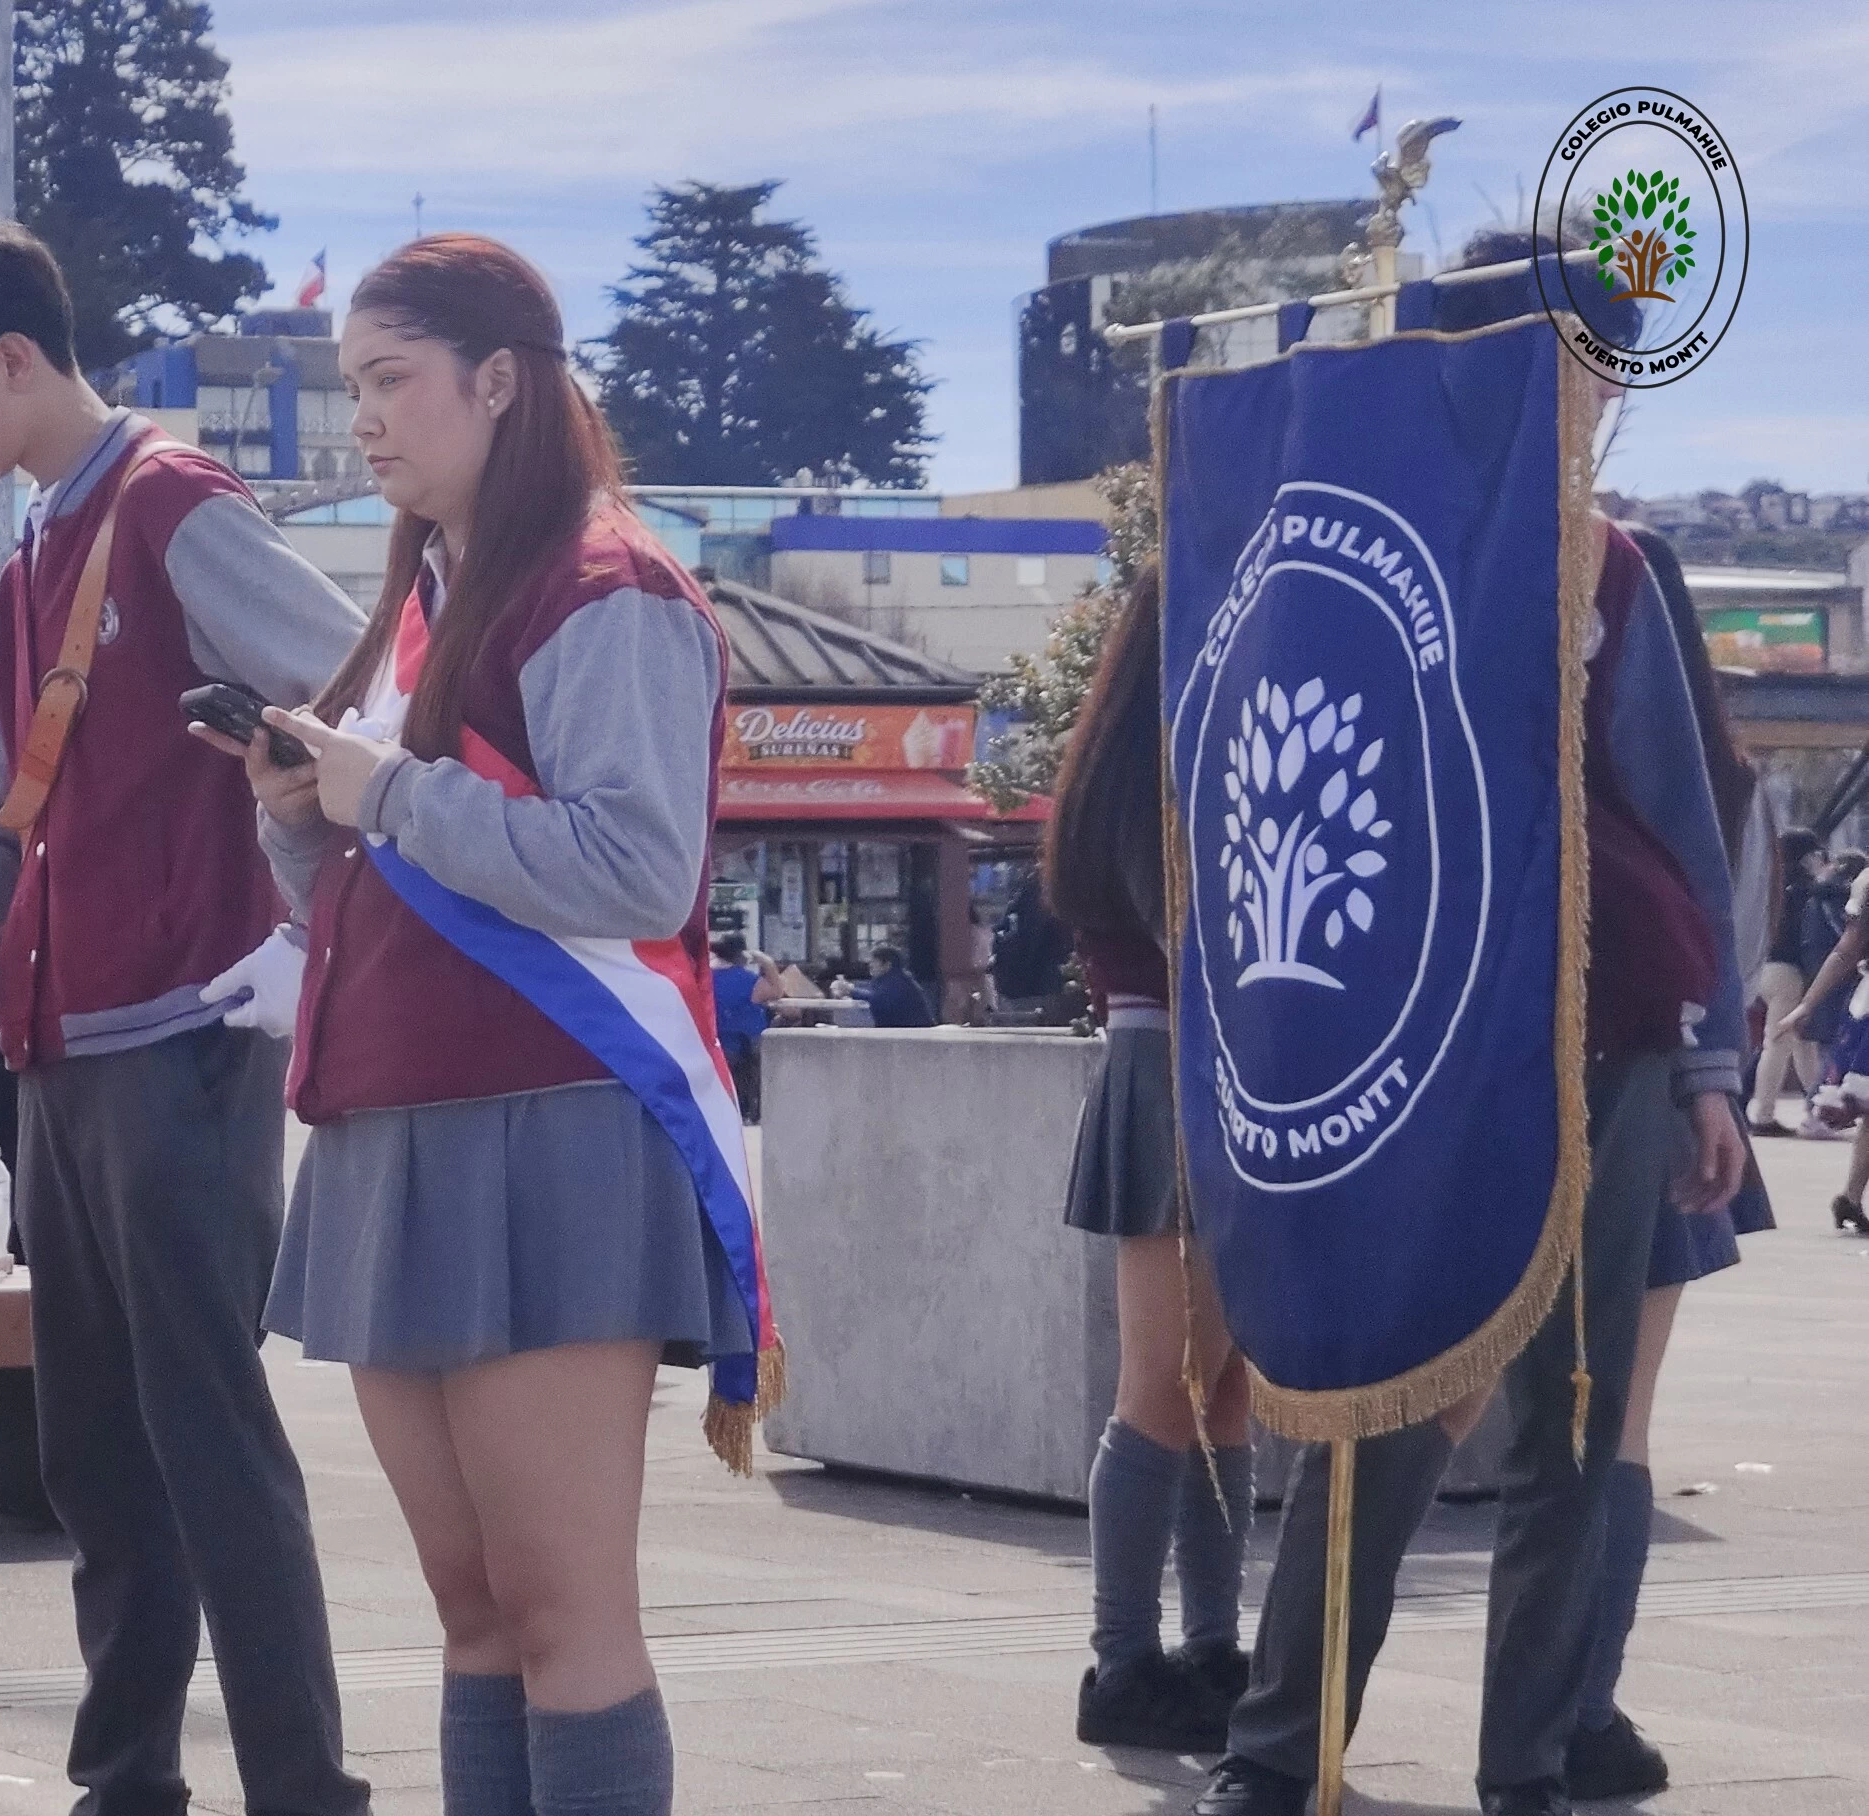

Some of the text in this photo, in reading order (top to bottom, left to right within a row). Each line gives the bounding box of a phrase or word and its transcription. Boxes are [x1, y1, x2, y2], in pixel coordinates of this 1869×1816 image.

[1281, 515, 1445, 673] PULMAHUE
[734, 707, 866, 743] Delicias
[1287, 1057, 1409, 1159] MONTT
